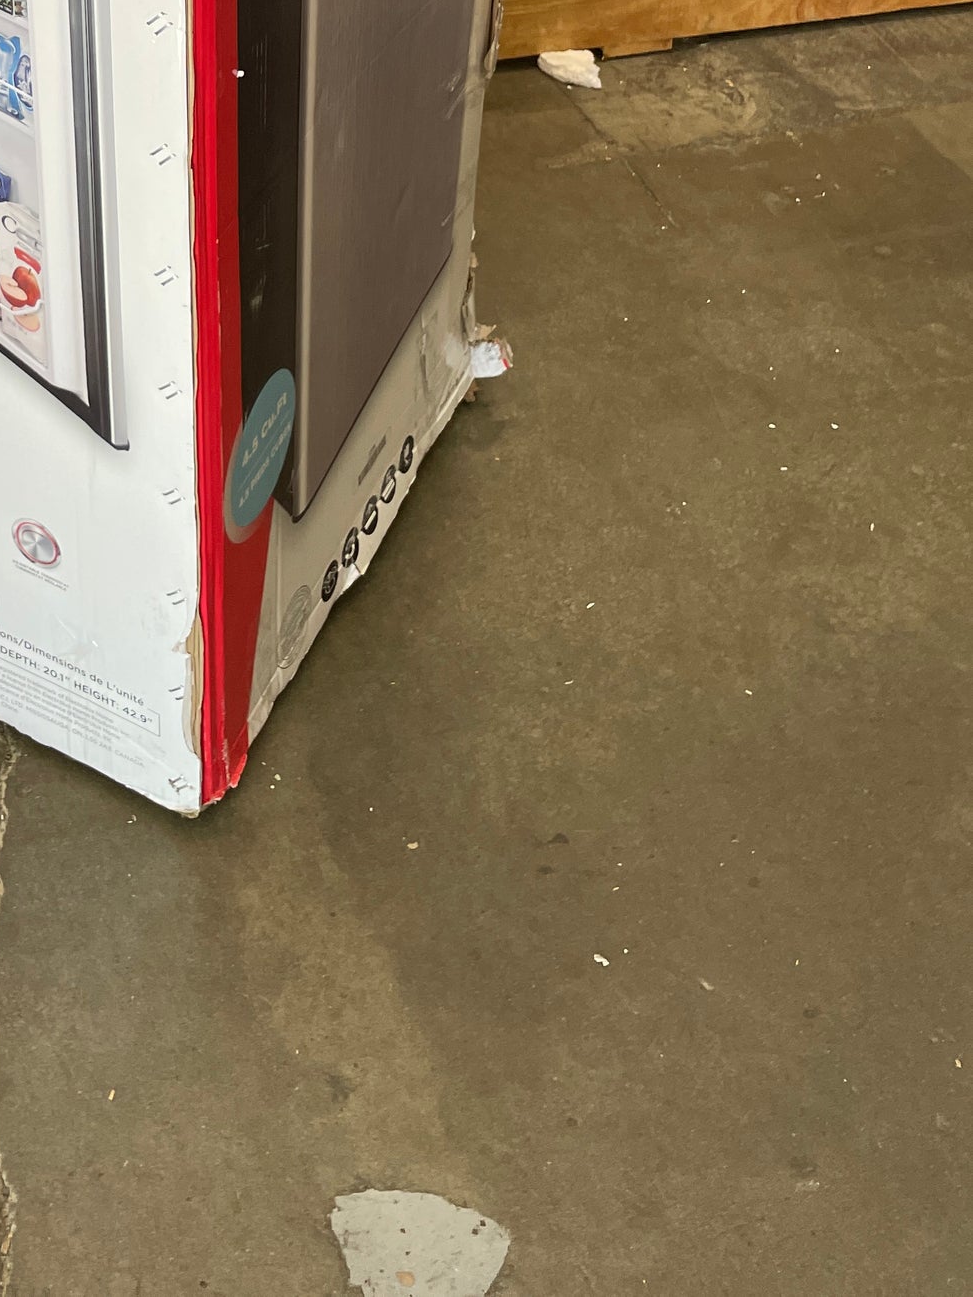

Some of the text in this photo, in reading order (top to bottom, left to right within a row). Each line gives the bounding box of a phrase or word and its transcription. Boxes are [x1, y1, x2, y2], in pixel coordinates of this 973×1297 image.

[0, 643, 41, 671] DEPTH:
[74, 680, 120, 712] HEIGHT:
[88, 672, 103, 684] de
